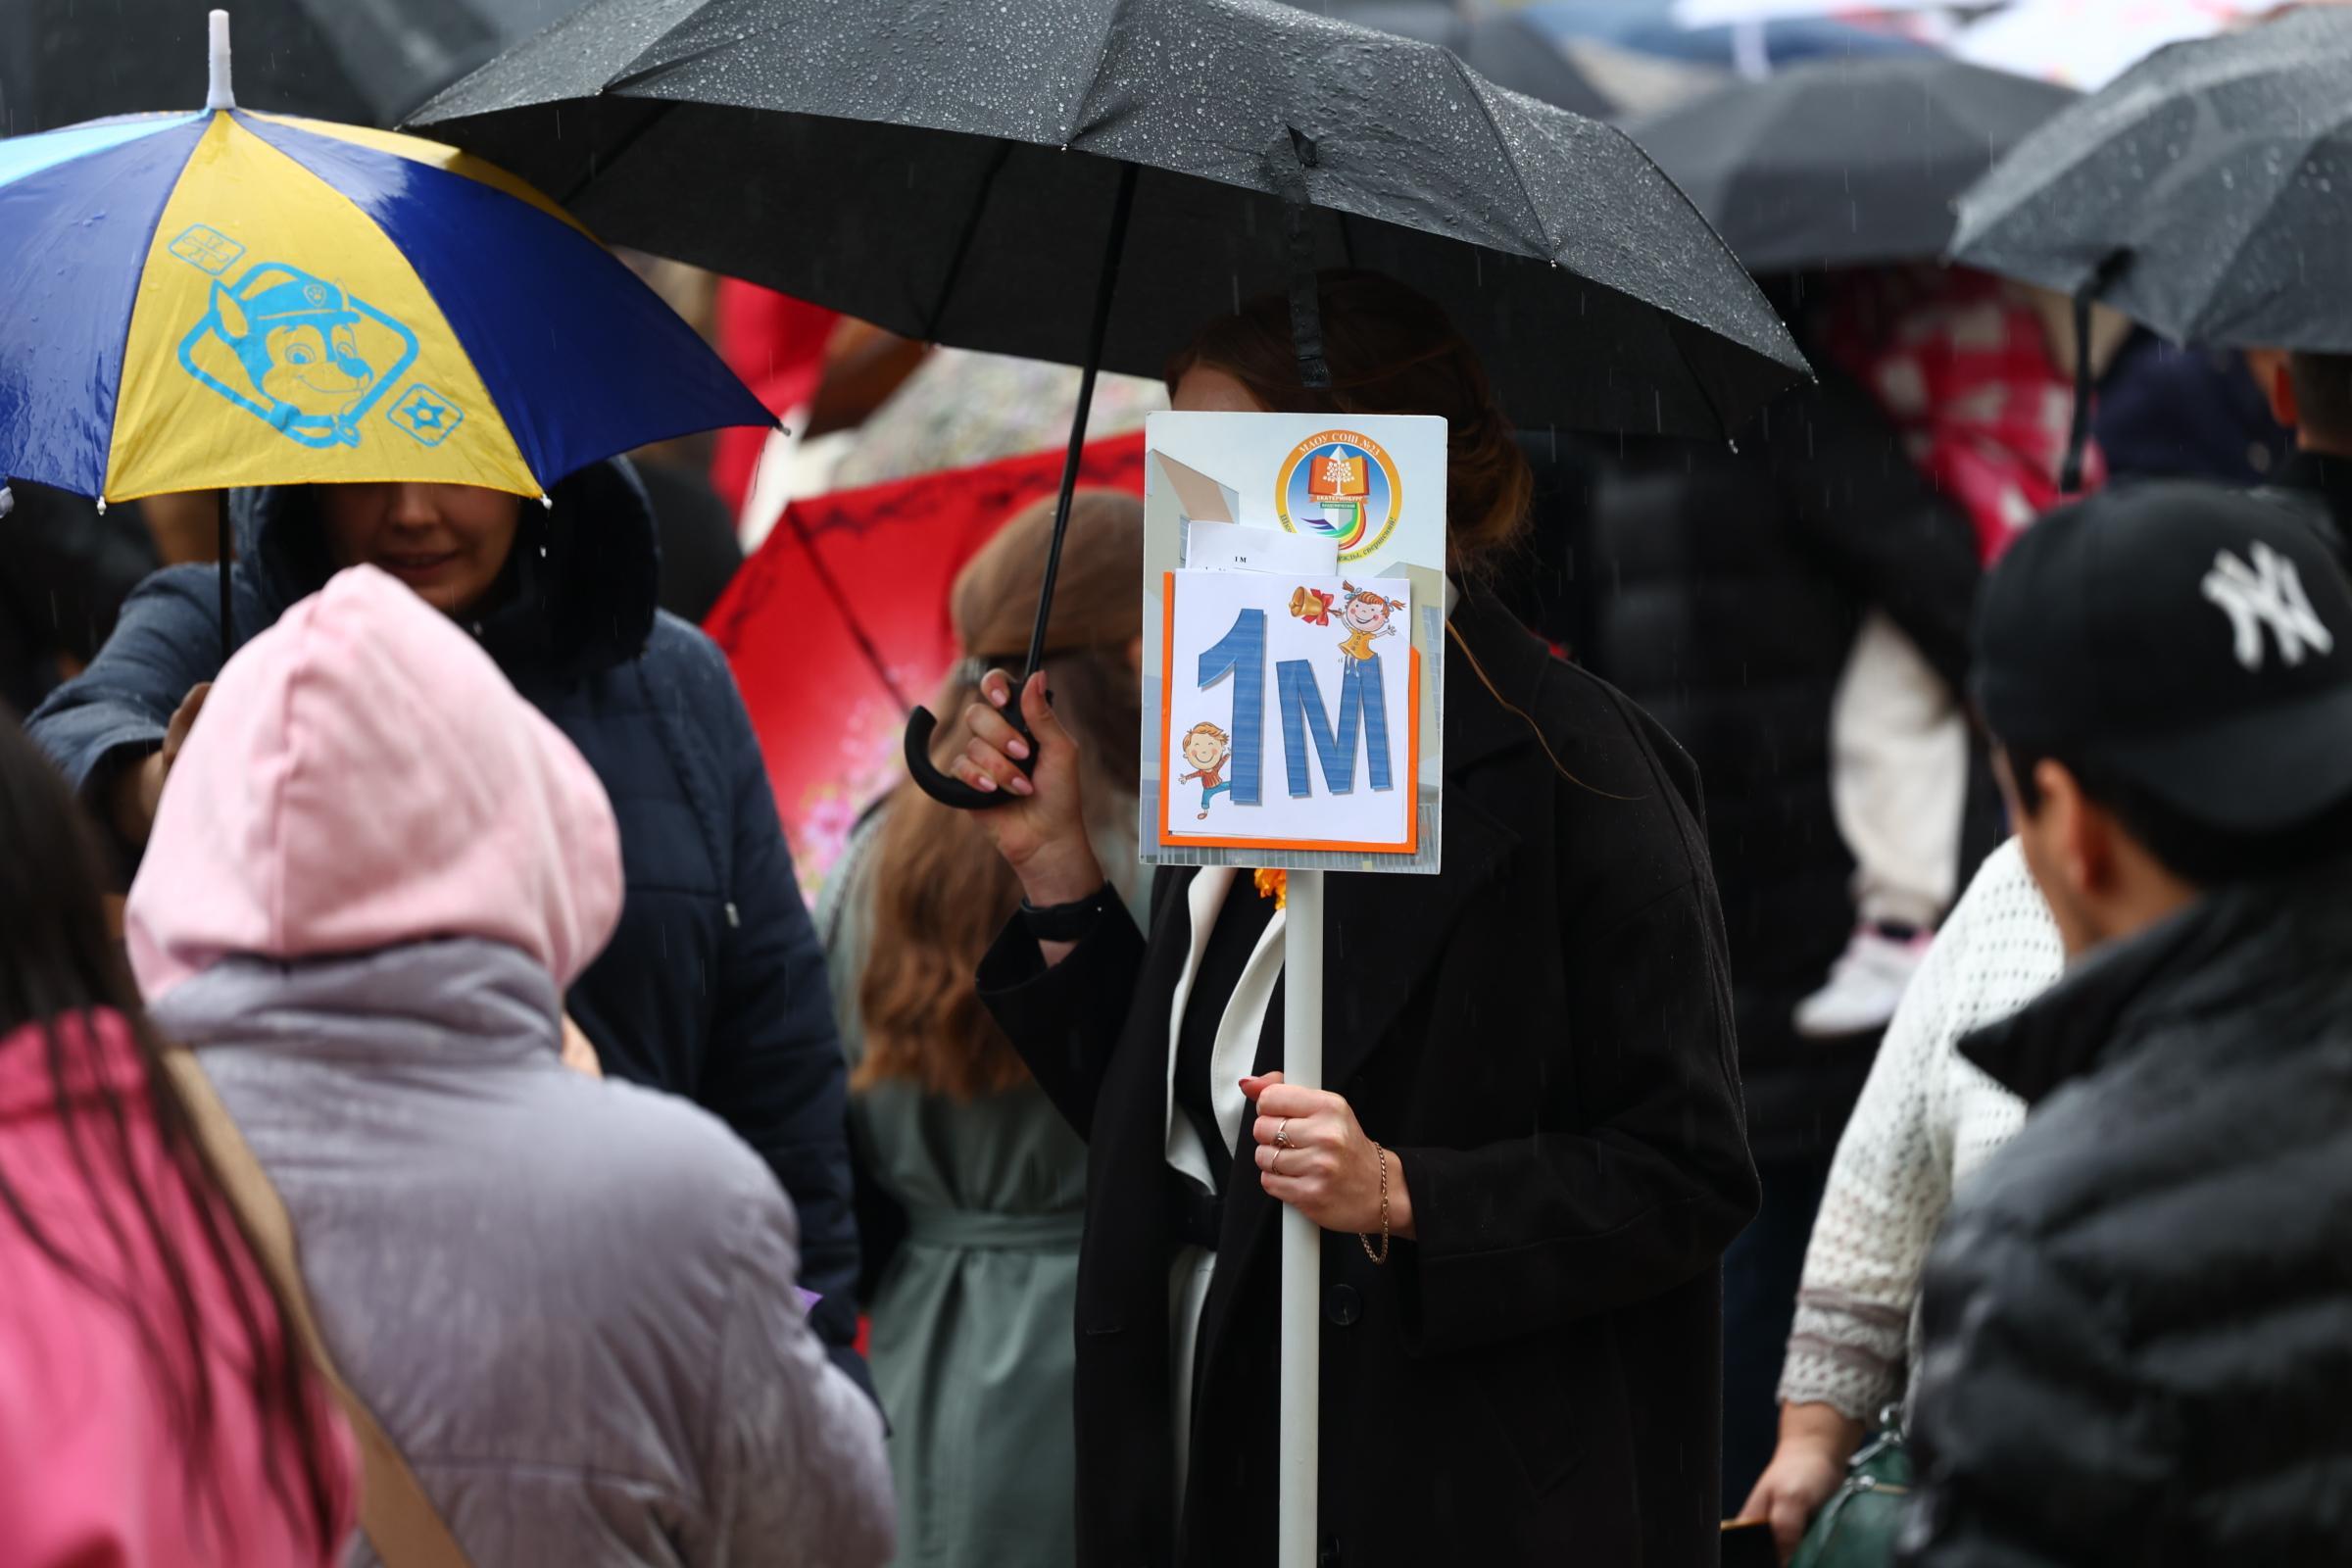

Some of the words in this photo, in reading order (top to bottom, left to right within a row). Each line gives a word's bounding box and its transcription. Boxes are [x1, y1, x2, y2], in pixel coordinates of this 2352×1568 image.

[1298, 433, 1329, 455] МАОУ
[1332, 433, 1358, 444] СОШ
[2201, 540, 2333, 670] NY
